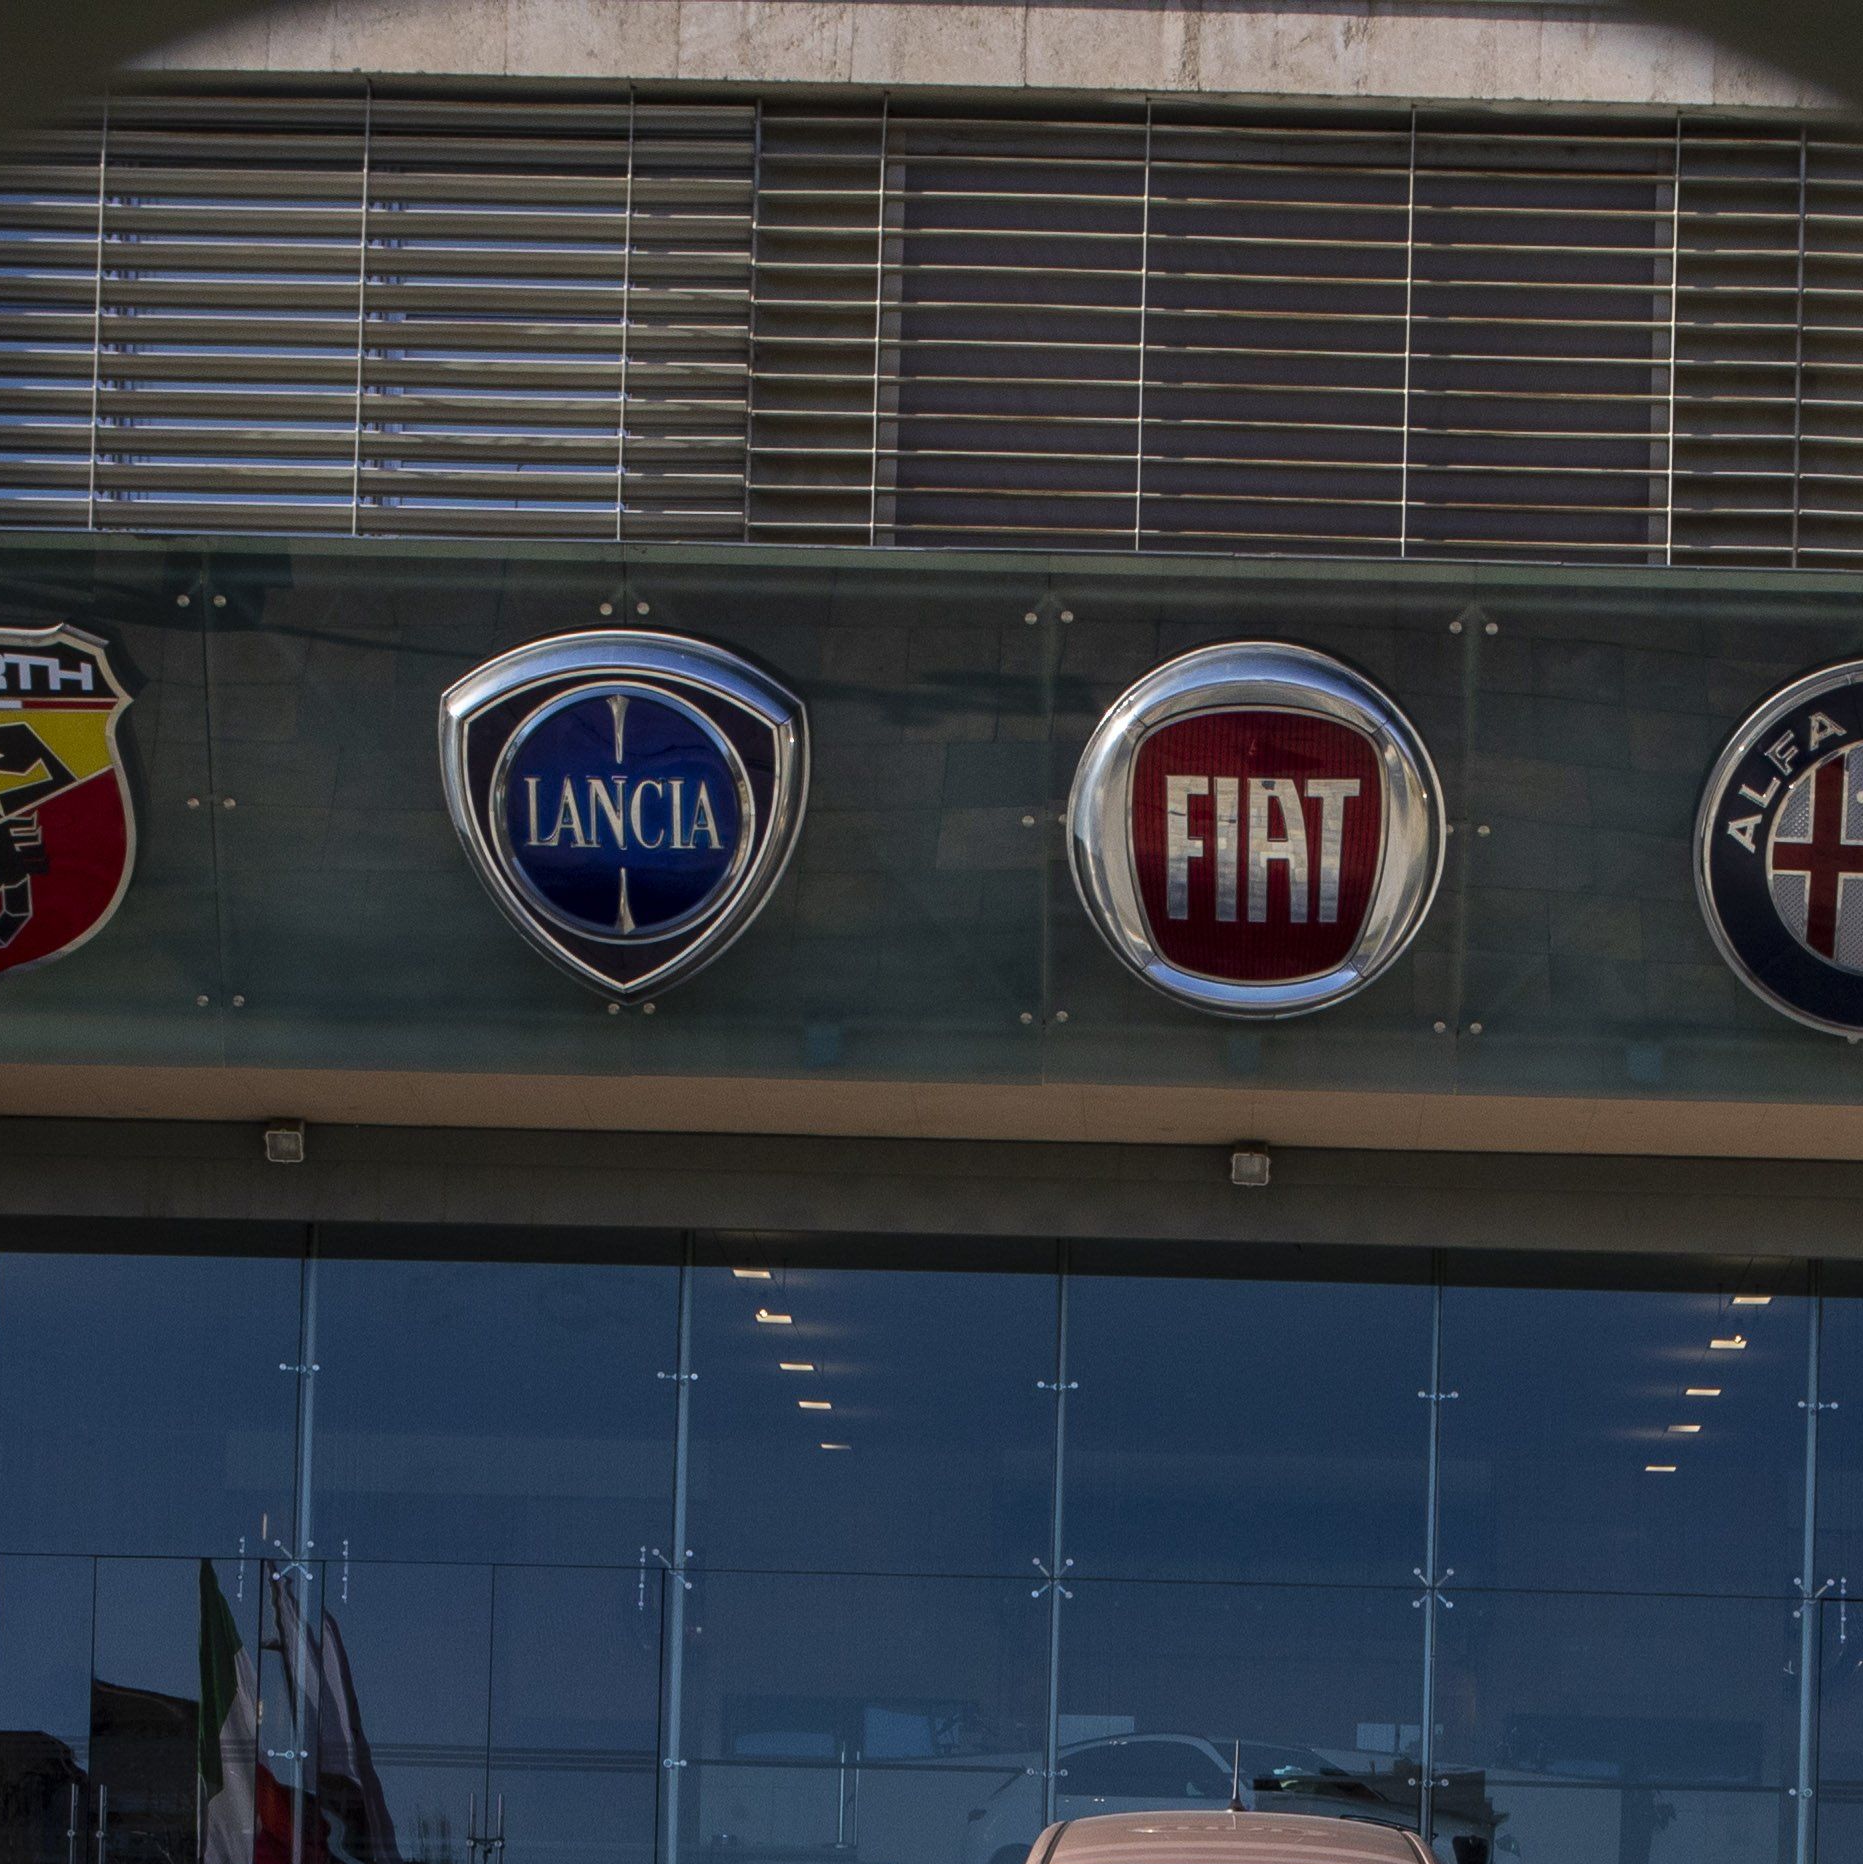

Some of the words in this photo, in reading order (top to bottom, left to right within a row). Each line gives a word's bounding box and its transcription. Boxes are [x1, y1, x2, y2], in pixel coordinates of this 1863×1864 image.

[522, 773, 728, 853] LANCIA
[1164, 773, 1362, 925] FIAT
[1724, 708, 1848, 856] ALFA
